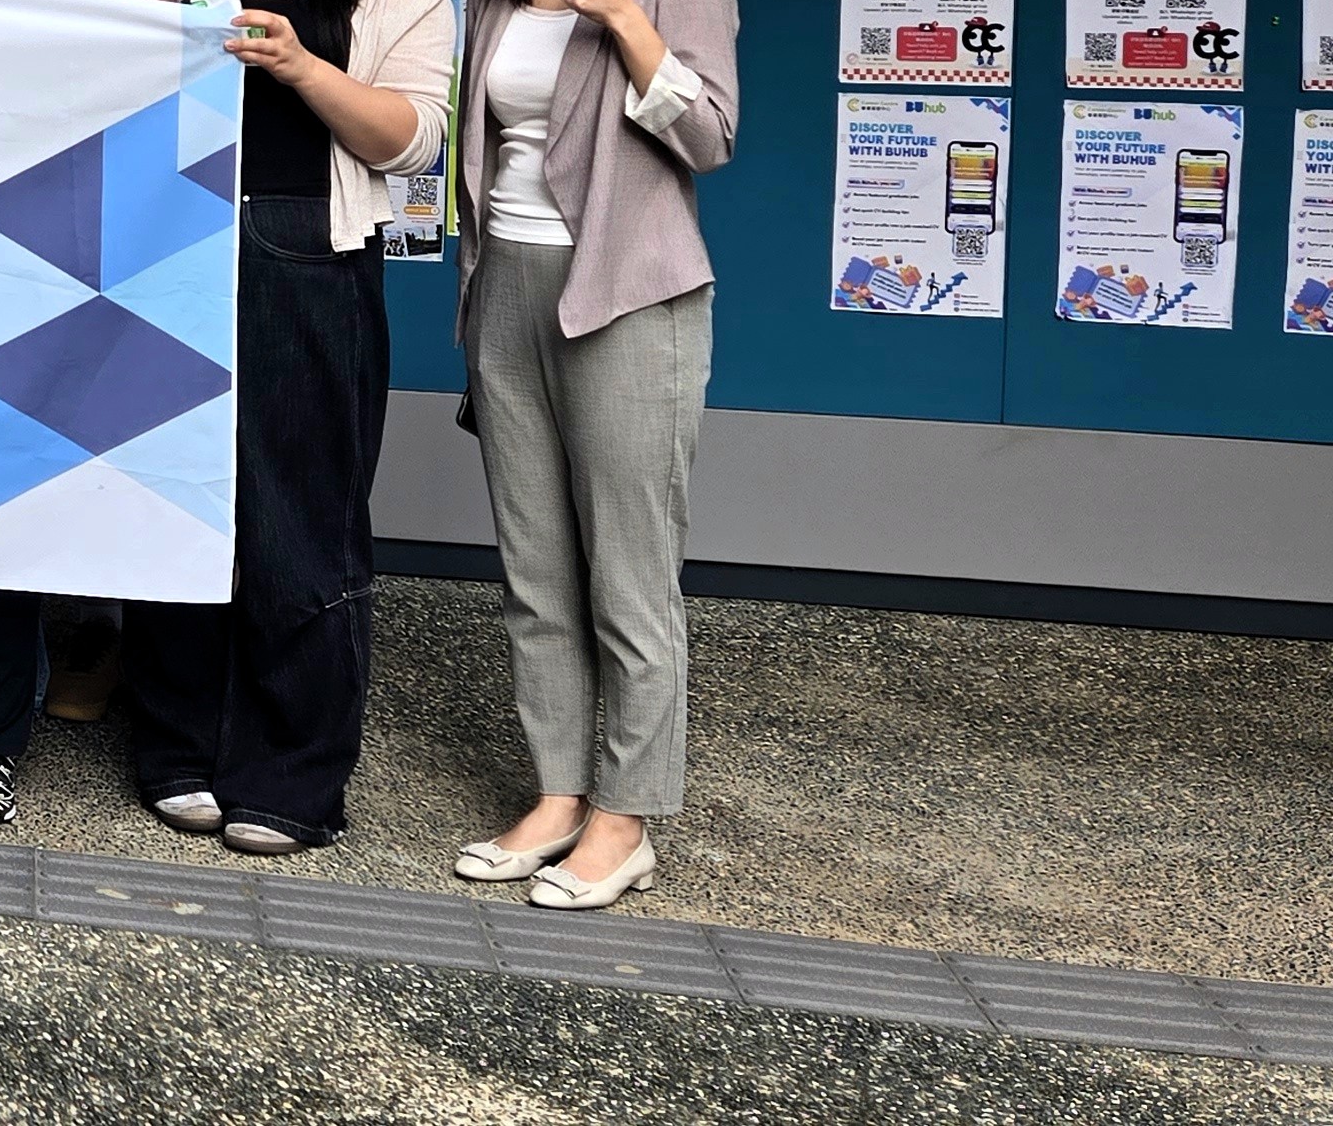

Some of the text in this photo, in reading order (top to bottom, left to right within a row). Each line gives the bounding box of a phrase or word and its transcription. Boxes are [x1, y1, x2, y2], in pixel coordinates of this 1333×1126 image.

[849, 122, 914, 134] DISCOVER
[849, 134, 937, 146] YOUR FUTURE
[1075, 129, 1142, 142] DISCOVER
[848, 145, 928, 158] WITH BUHUB
[1075, 142, 1166, 154] YOUR FUTURE
[1074, 153, 1157, 166] WITH BUHUB
